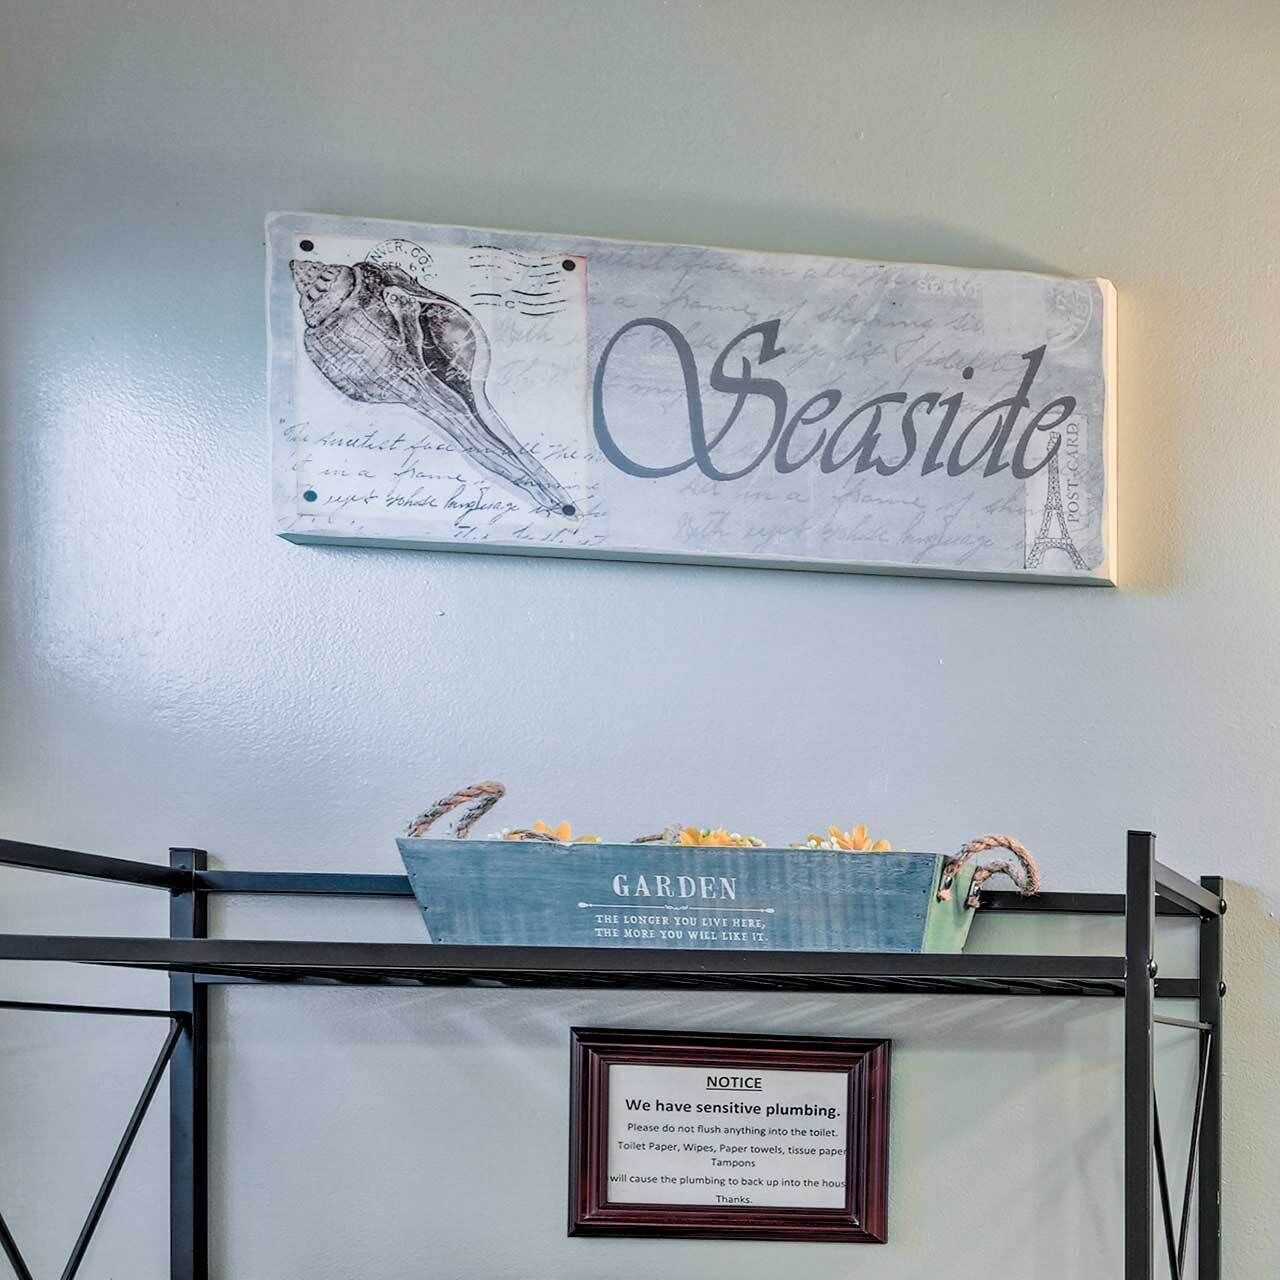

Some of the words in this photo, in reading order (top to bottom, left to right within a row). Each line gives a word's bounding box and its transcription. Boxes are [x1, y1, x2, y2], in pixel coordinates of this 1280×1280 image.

[593, 317, 1076, 481] Seaside
[613, 874, 737, 900] GARDEN
[595, 915, 619, 924] THE
[623, 915, 670, 925] LONGER
[674, 916, 697, 927] YOU
[702, 918, 729, 927] LIVE
[733, 918, 766, 929] HERE,
[594, 928, 619, 937] THE
[623, 928, 655, 938] MORE
[659, 930, 683, 940] YOU
[687, 931, 717, 940] WILL
[722, 932, 751, 941] LIKE
[752, 932, 769, 942] IT.
[706, 1076, 763, 1090] NOTICE
[625, 1099, 651, 1111] We
[656, 1100, 692, 1113] have
[696, 1102, 761, 1114] sensitive
[766, 1103, 841, 1119] plumbing.
[627, 1122, 659, 1132] Please
[662, 1124, 675, 1133] do
[678, 1125, 695, 1134] not
[697, 1124, 721, 1134] flush
[724, 1126, 766, 1137] anything
[768, 1127, 788, 1136] into
[790, 1127, 807, 1136] the
[809, 1128, 838, 1137] toilet.
[618, 1141, 646, 1151] Toilet
[648, 1142, 680, 1152] Paper,
[683, 1143, 717, 1153] Wipes,
[719, 1143, 748, 1154] Paper
[750, 1145, 785, 1155] towels,
[788, 1146, 816, 1155] tissue
[711, 1158, 756, 1168] Tampons
[610, 1174, 627, 1182] will
[660, 1175, 677, 1184] the
[680, 1175, 726, 1187] plumbing
[728, 1177, 739, 1185] to
[741, 1177, 764, 1186] back
[766, 1180, 779, 1188] up
[781, 1177, 801, 1187] into
[803, 1178, 820, 1188] the
[822, 1178, 848, 1188] hous
[715, 1194, 753, 1204] Thanks.
